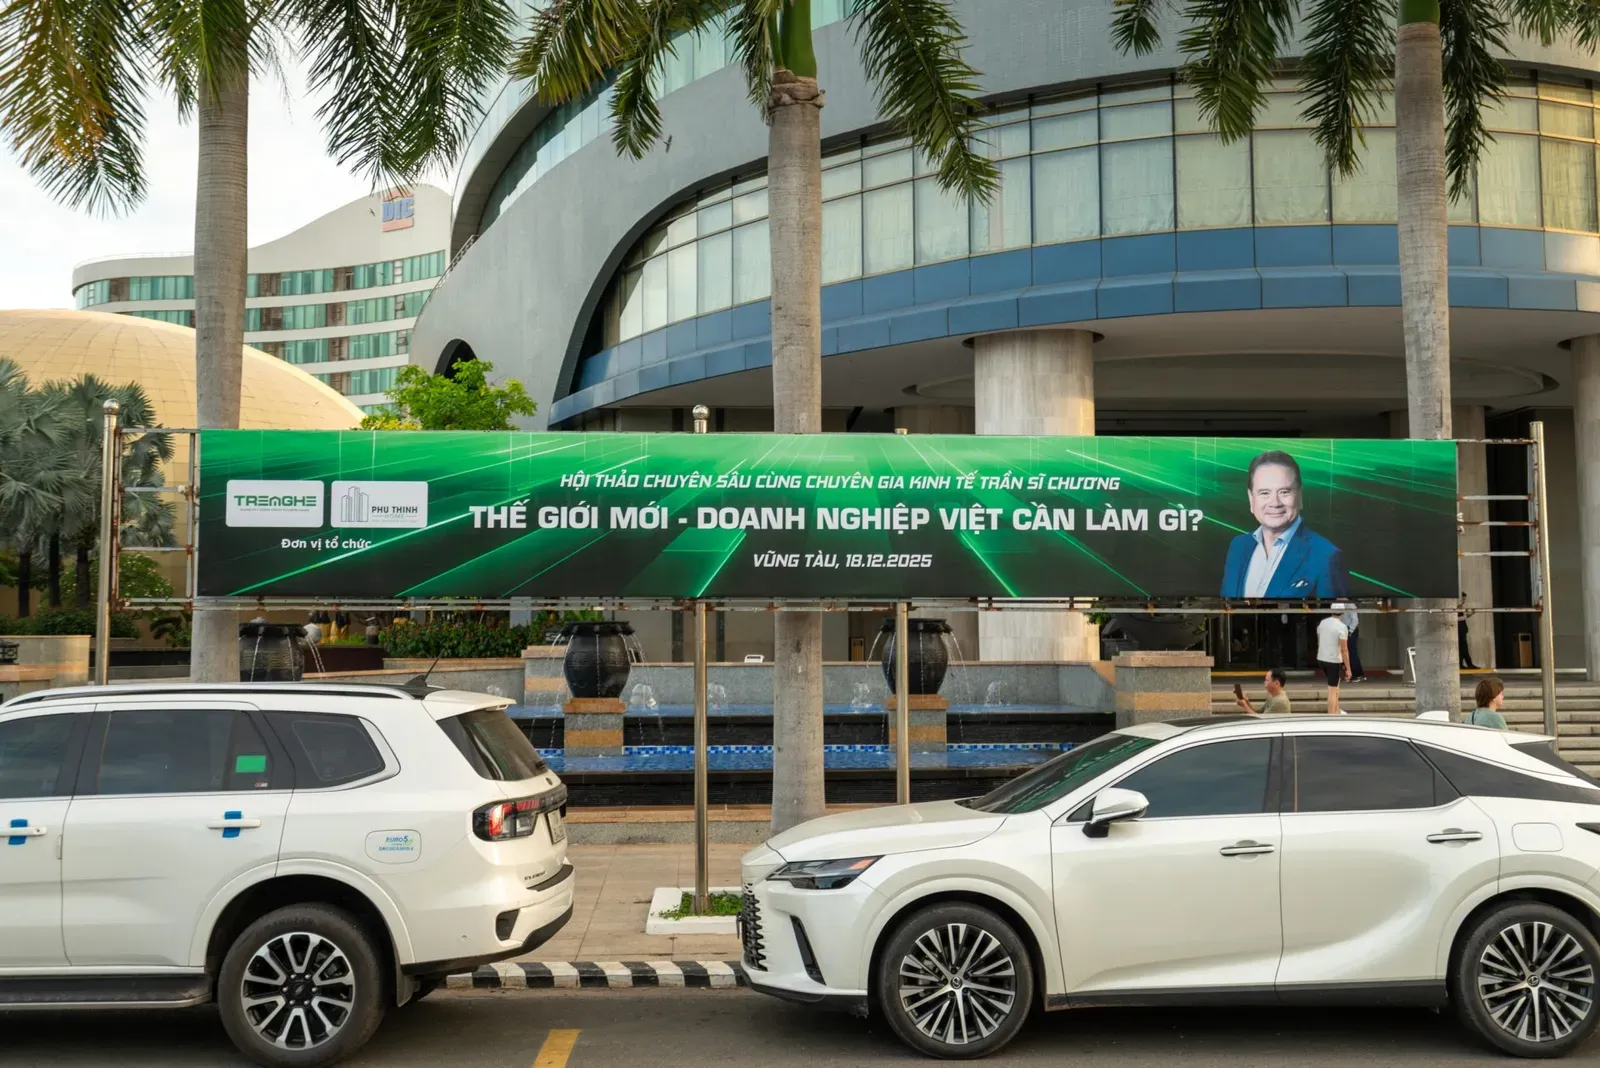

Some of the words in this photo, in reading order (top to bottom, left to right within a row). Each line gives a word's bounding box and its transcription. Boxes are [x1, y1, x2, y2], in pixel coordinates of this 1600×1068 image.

[560, 470, 590, 491] HỘI
[595, 470, 640, 488] THẢO
[643, 471, 712, 488] CHUYÊN
[716, 471, 752, 488] SÂU
[755, 471, 802, 489] CÙNG
[805, 472, 874, 489] CHUYÊN
[877, 475, 904, 489] GIA
[909, 476, 951, 489] KINH
[956, 470, 978, 490] TẾ
[980, 470, 1024, 490] TRẦN
[1027, 473, 1046, 490] SĨ
[1047, 477, 1120, 490] CHƯƠNG
[469, 499, 530, 528] THẾ
[538, 501, 598, 529] GIỚI
[610, 501, 669, 529] MỚI
[697, 507, 805, 530] DOANH
[816, 502, 930, 535] NGHIỆP
[938, 502, 1003, 535] VIỆT
[1012, 501, 1075, 531] CẦN
[1086, 503, 1148, 531] LÀM
[1158, 503, 1204, 532] GÌ?
[281, 538, 307, 549] Đơn
[310, 538, 322, 551] vị
[325, 535, 339, 549] tổ
[342, 538, 372, 549] chức
[753, 550, 800, 567] VŨNG
[805, 550, 840, 569] TÀU,
[845, 554, 932, 567] 18.12.2025
